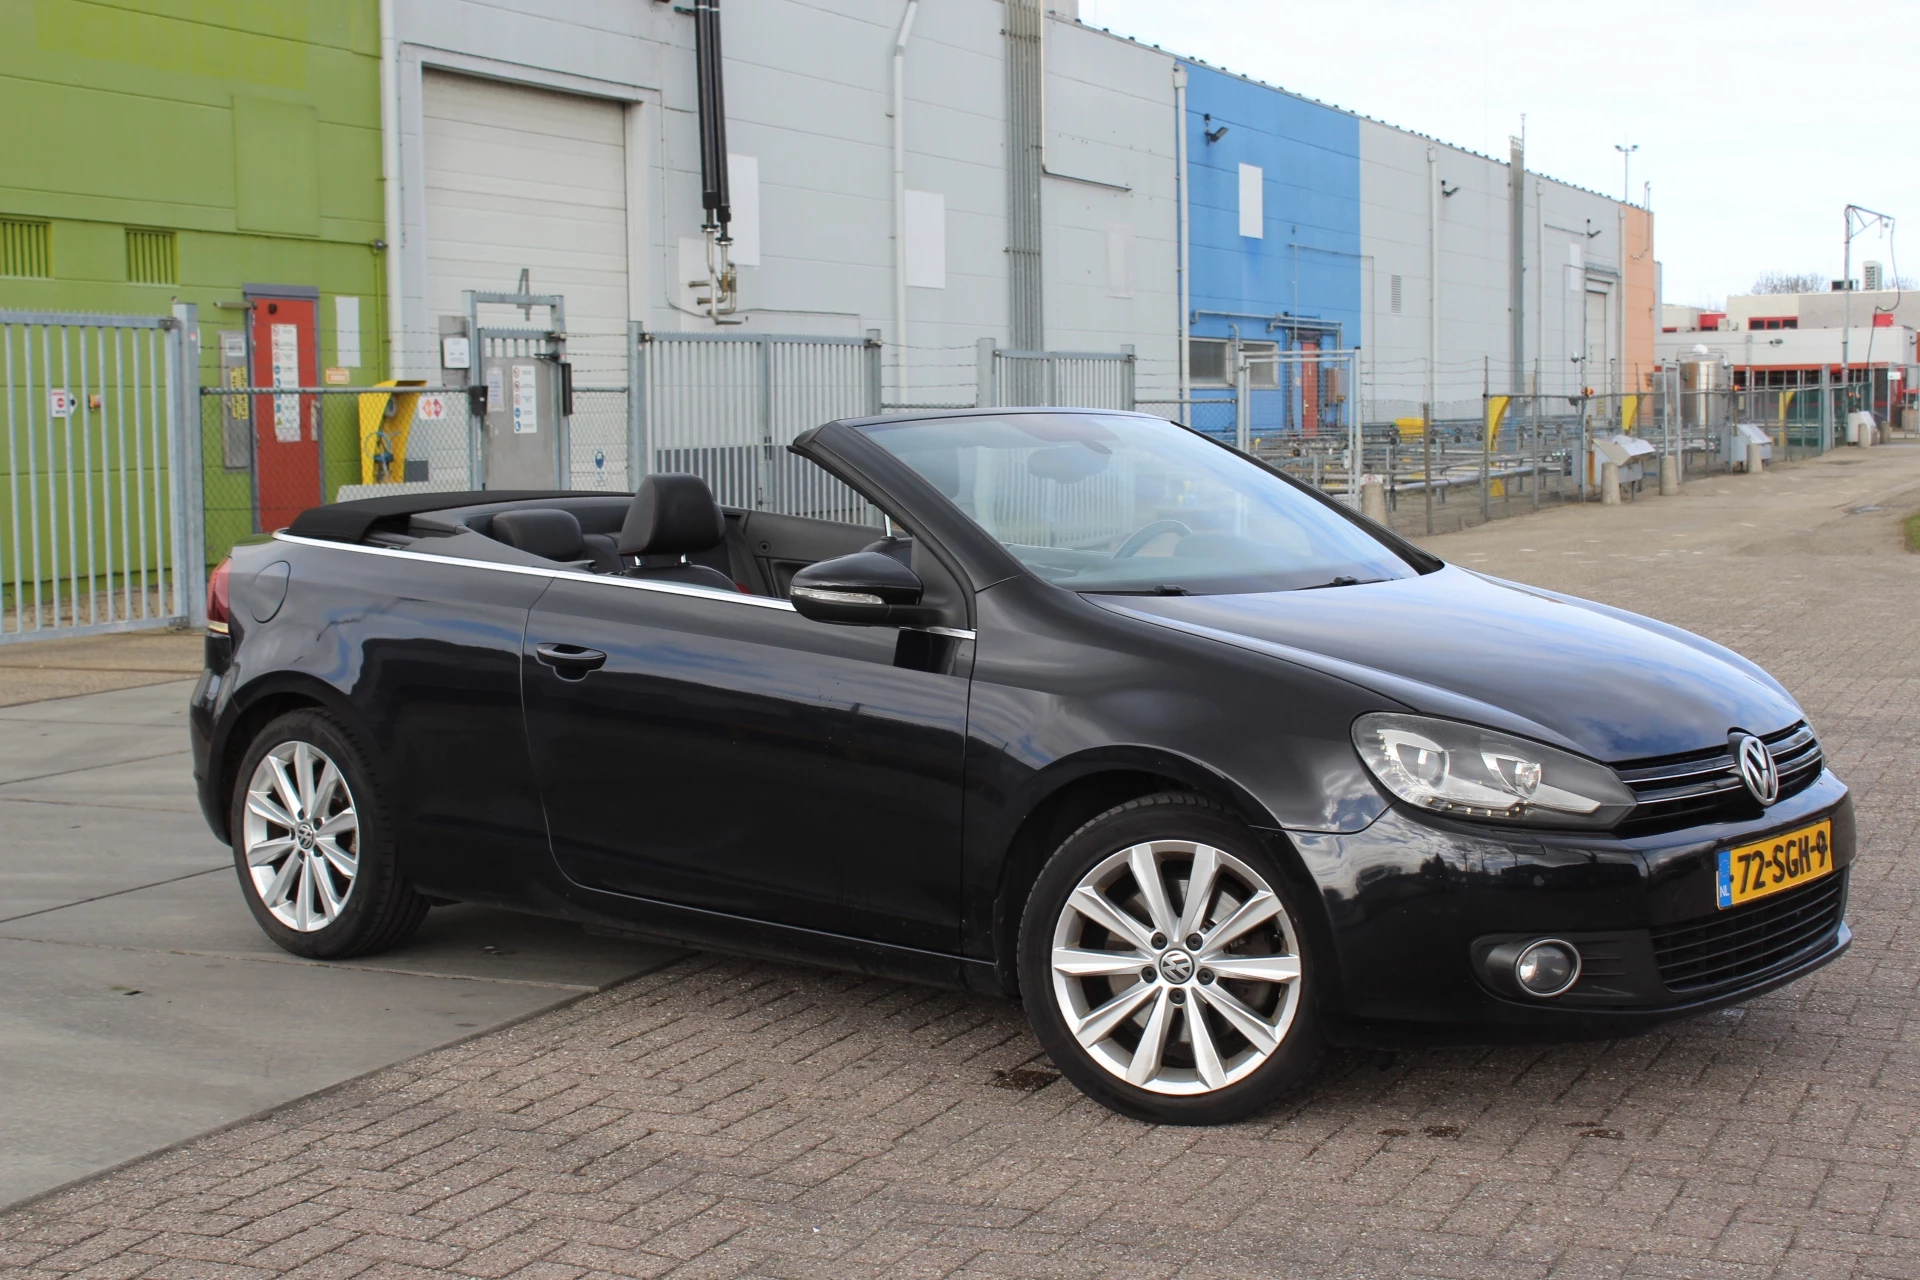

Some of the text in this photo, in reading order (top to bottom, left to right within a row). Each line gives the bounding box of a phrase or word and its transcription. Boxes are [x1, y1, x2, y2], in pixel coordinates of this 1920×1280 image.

[516, 268, 532, 322] 4
[1741, 738, 1777, 804] VW
[1719, 885, 1730, 898] NL
[1737, 829, 1828, 895] 72-SGH-9
